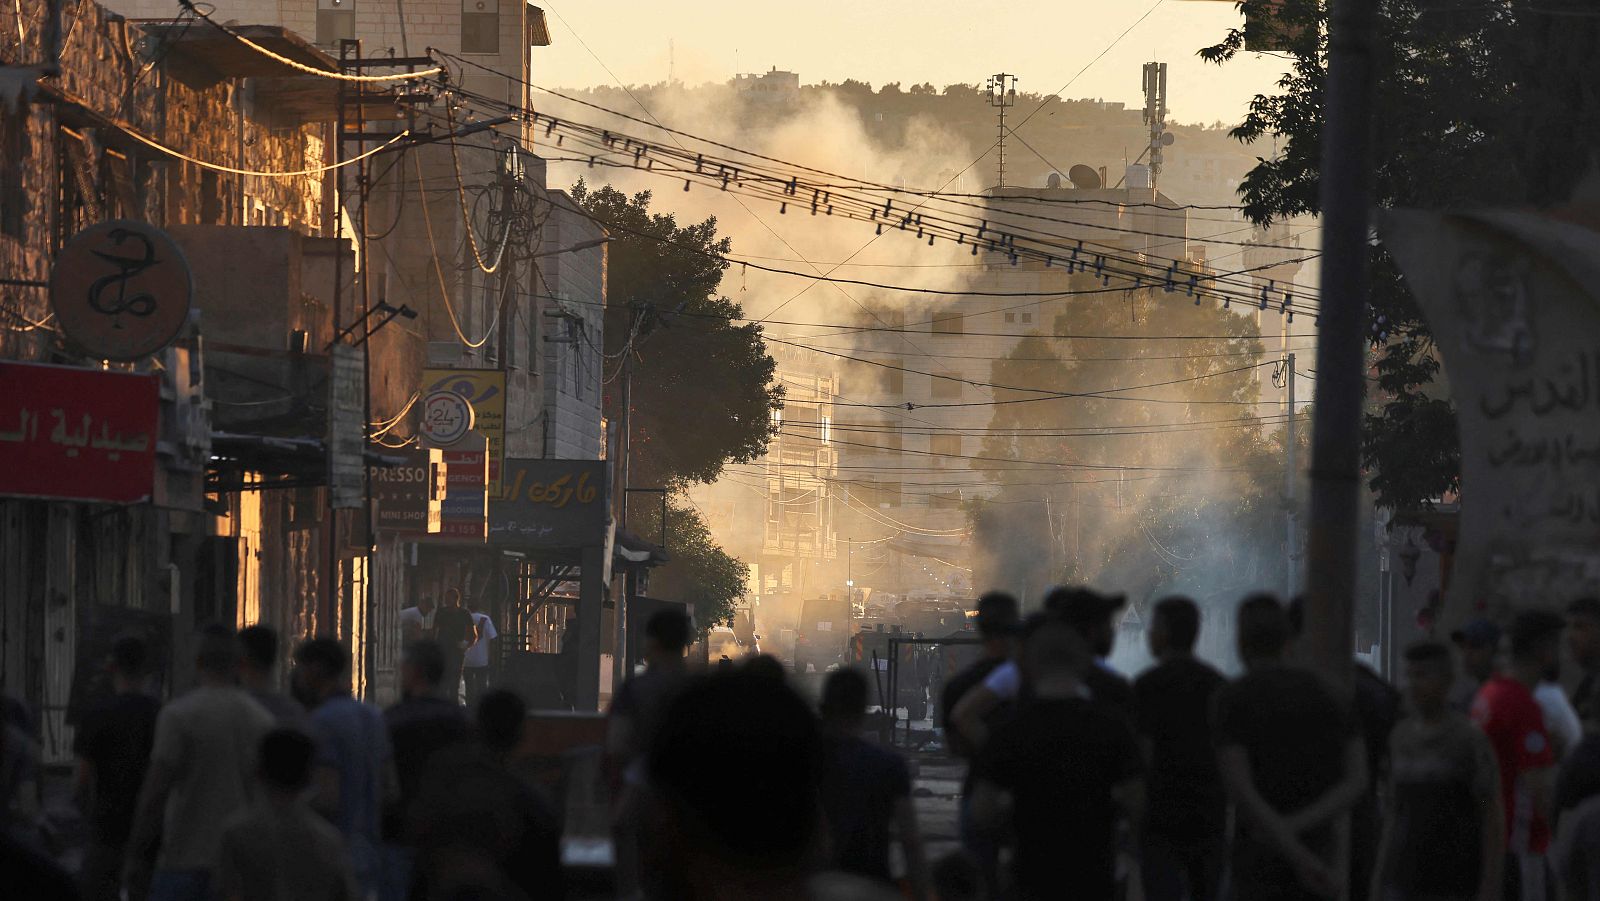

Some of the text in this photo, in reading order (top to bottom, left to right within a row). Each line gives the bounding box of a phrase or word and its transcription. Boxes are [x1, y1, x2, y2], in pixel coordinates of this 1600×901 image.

[433, 408, 454, 425] 24
[0, 407, 149, 462] صيدلية ال
[448, 474, 482, 482] GENCY
[403, 511, 425, 520] SHOP
